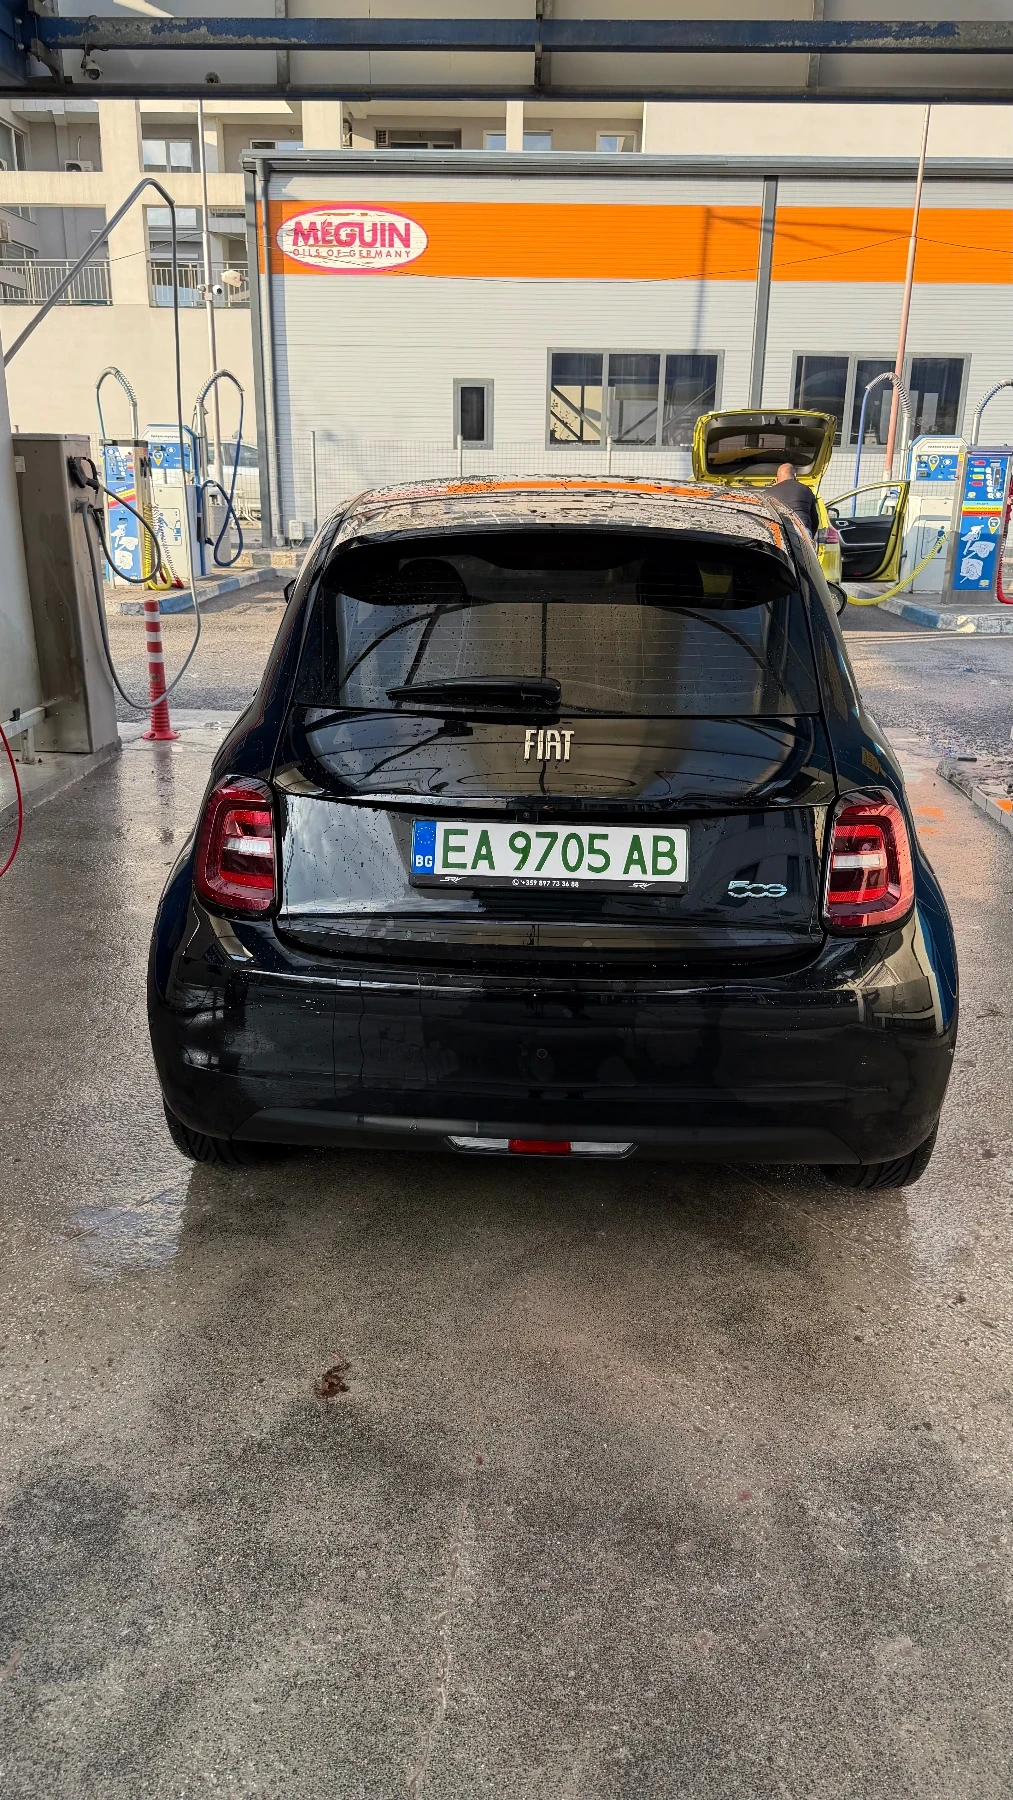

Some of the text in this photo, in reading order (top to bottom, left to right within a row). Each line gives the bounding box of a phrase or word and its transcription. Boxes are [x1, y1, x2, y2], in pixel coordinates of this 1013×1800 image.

[292, 218, 411, 249] MÉGUIN
[292, 248, 411, 258] OILS OF GERMANY
[524, 729, 575, 761] FIAT
[415, 854, 433, 868] BG
[442, 828, 678, 876] EA 9705 AB
